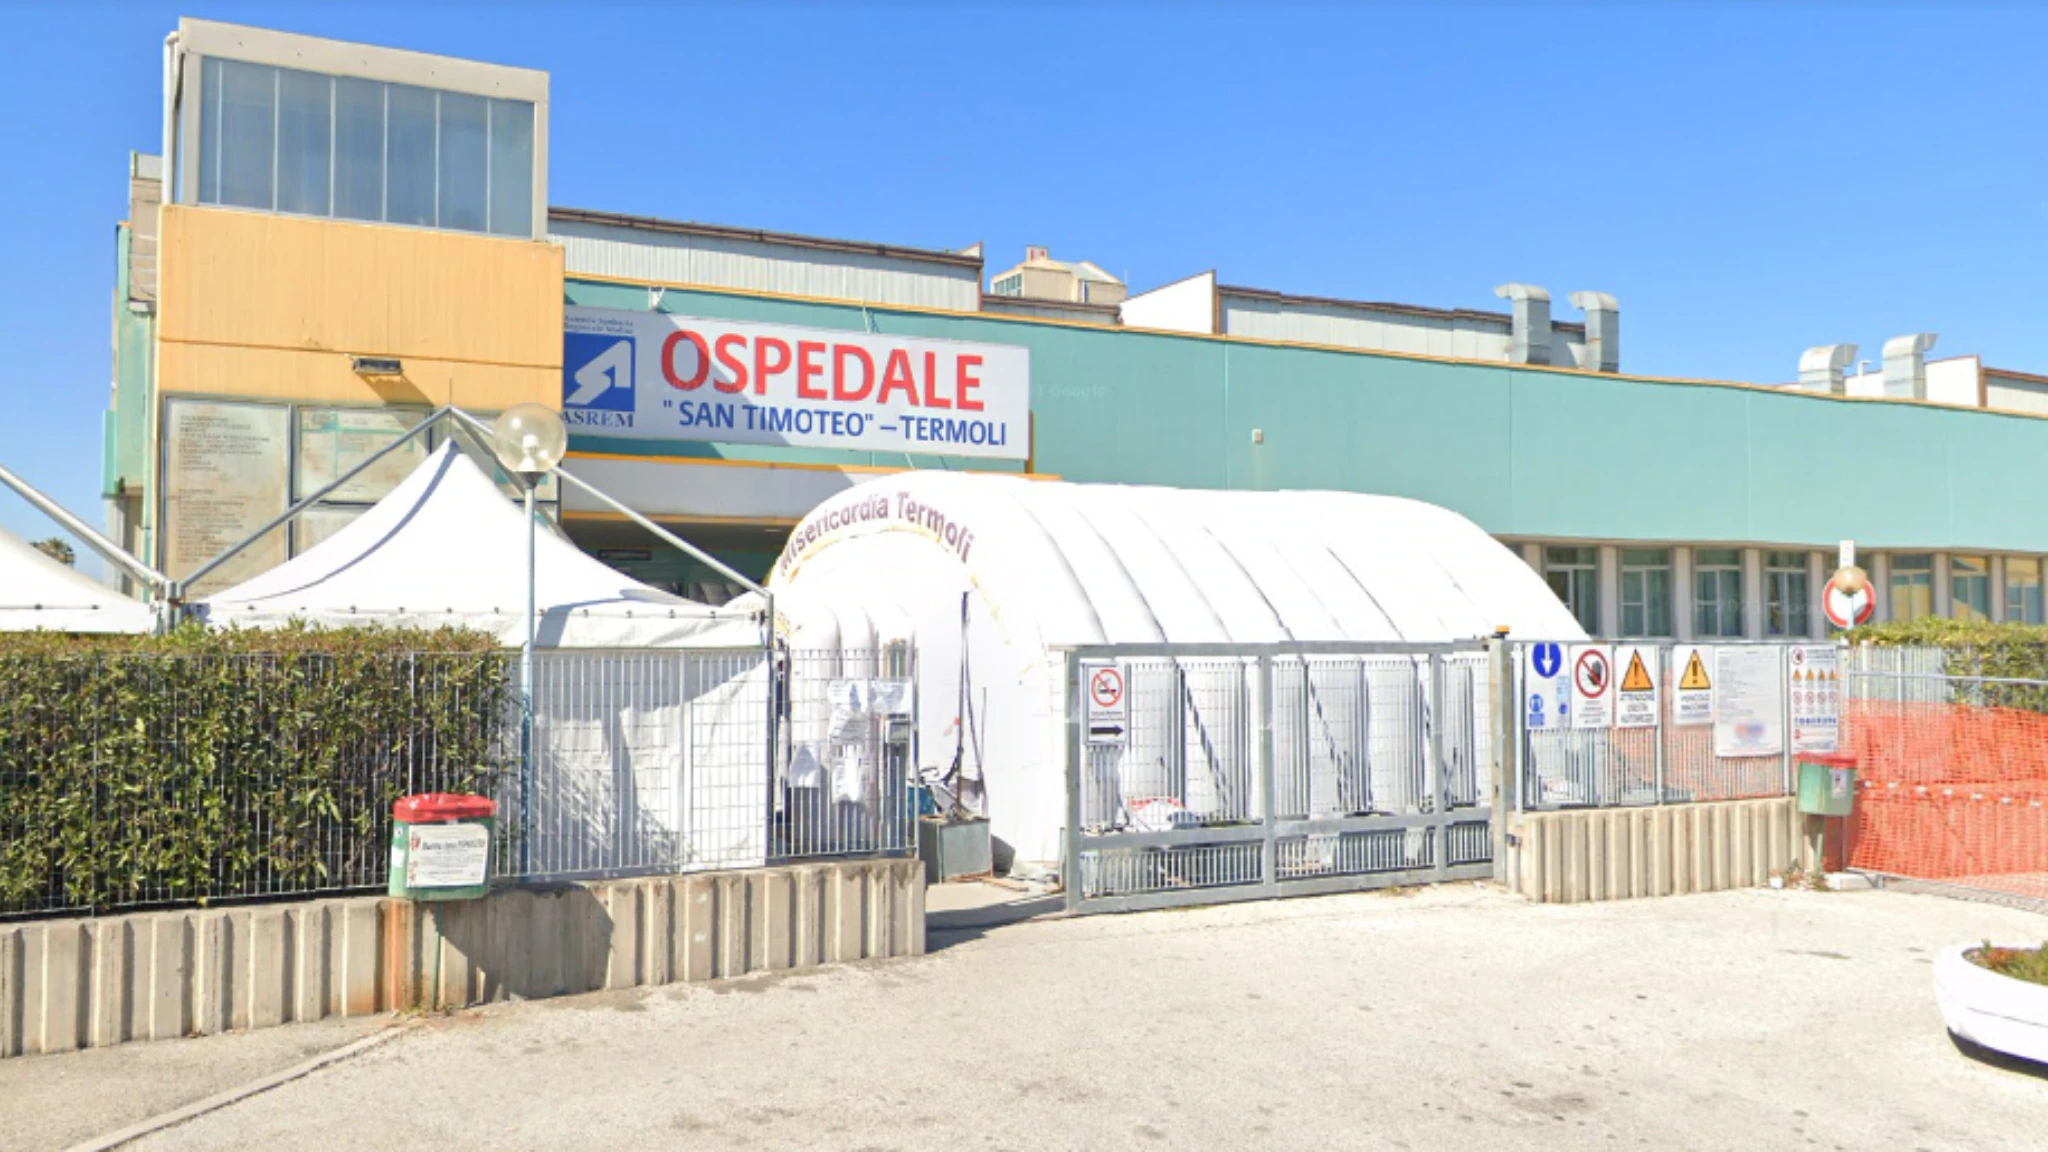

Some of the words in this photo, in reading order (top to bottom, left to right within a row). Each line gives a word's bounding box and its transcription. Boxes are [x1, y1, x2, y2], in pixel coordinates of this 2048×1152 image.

[661, 329, 985, 411] OSPEDALE
[742, 404, 874, 437] TIMOTEO"
[897, 491, 976, 564] Termoli
